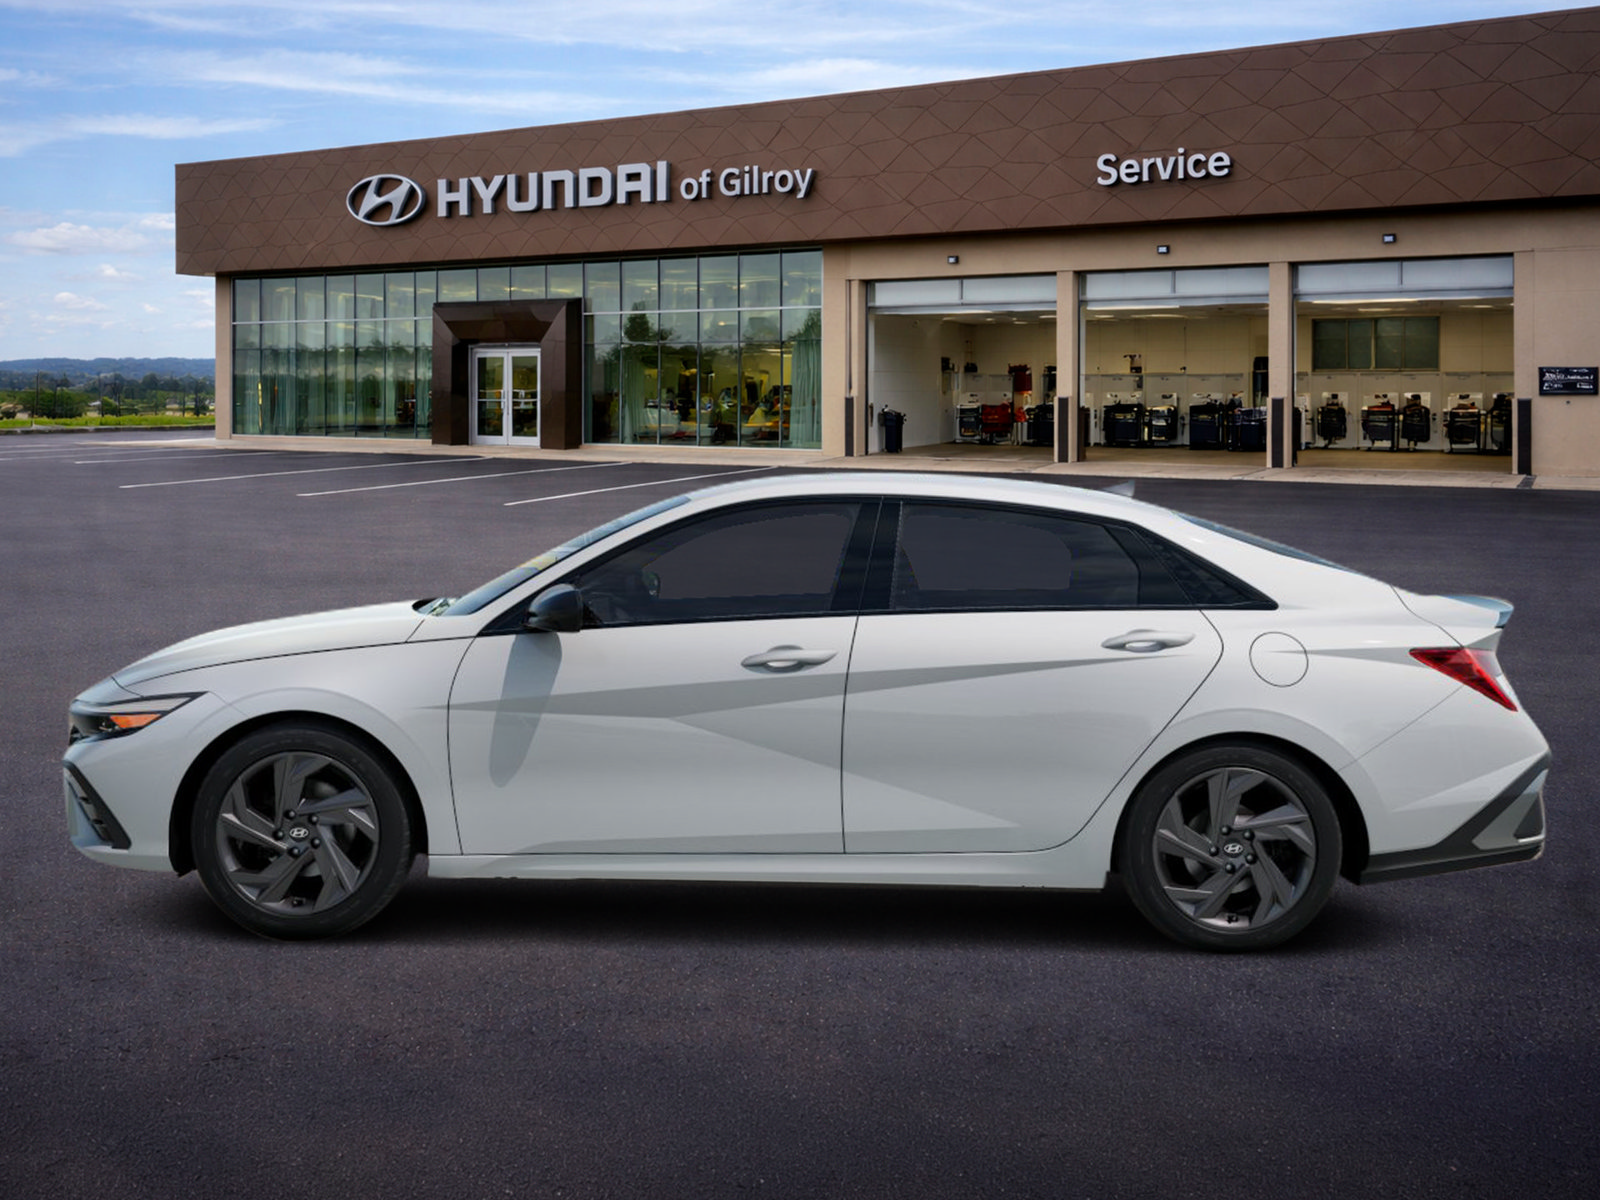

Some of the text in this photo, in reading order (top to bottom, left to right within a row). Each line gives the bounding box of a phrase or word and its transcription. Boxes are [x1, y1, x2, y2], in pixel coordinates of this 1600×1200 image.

[436, 160, 814, 218] HYUNDAI of Gilroy
[1096, 147, 1231, 186] Service
